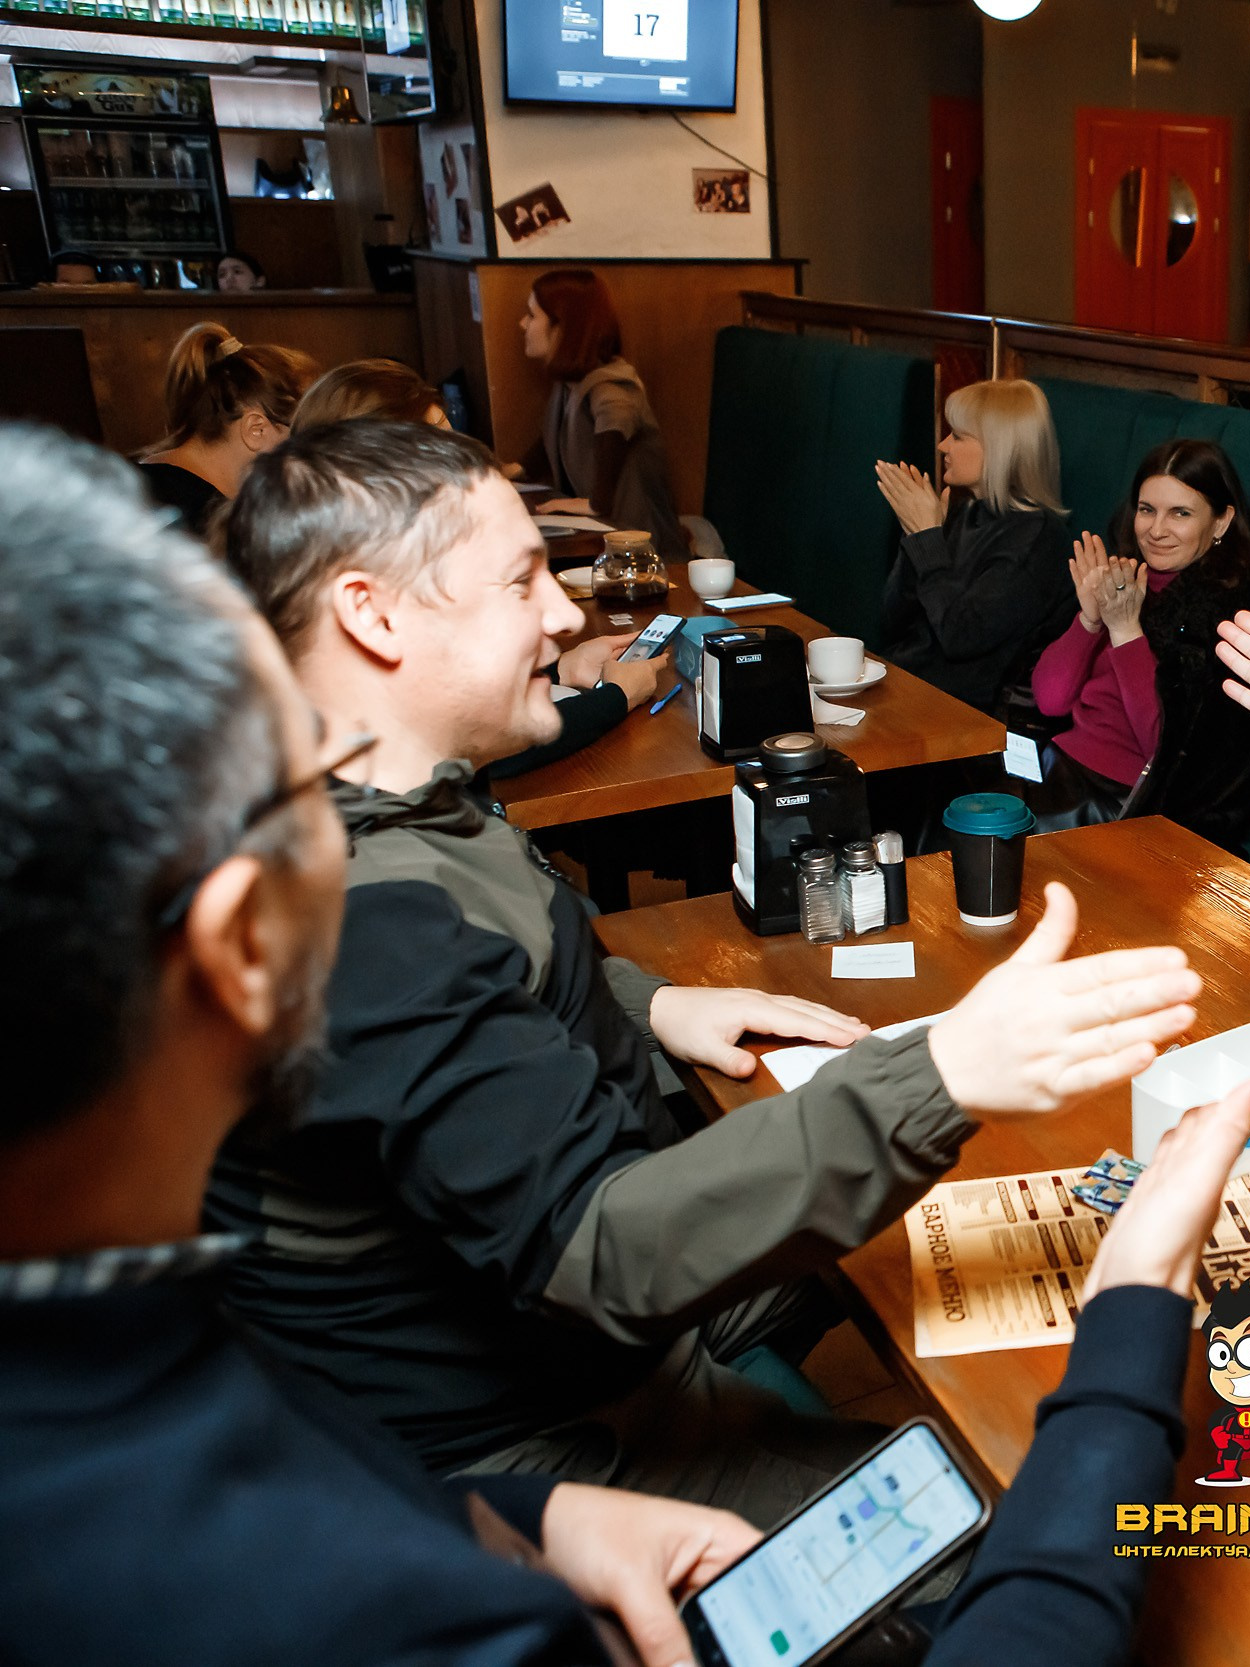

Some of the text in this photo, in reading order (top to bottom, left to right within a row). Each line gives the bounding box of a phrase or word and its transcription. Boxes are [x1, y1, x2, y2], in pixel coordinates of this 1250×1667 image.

[634, 13, 660, 37] 17
[921, 1203, 966, 1322] БАРНОЕ МЕНЮ
